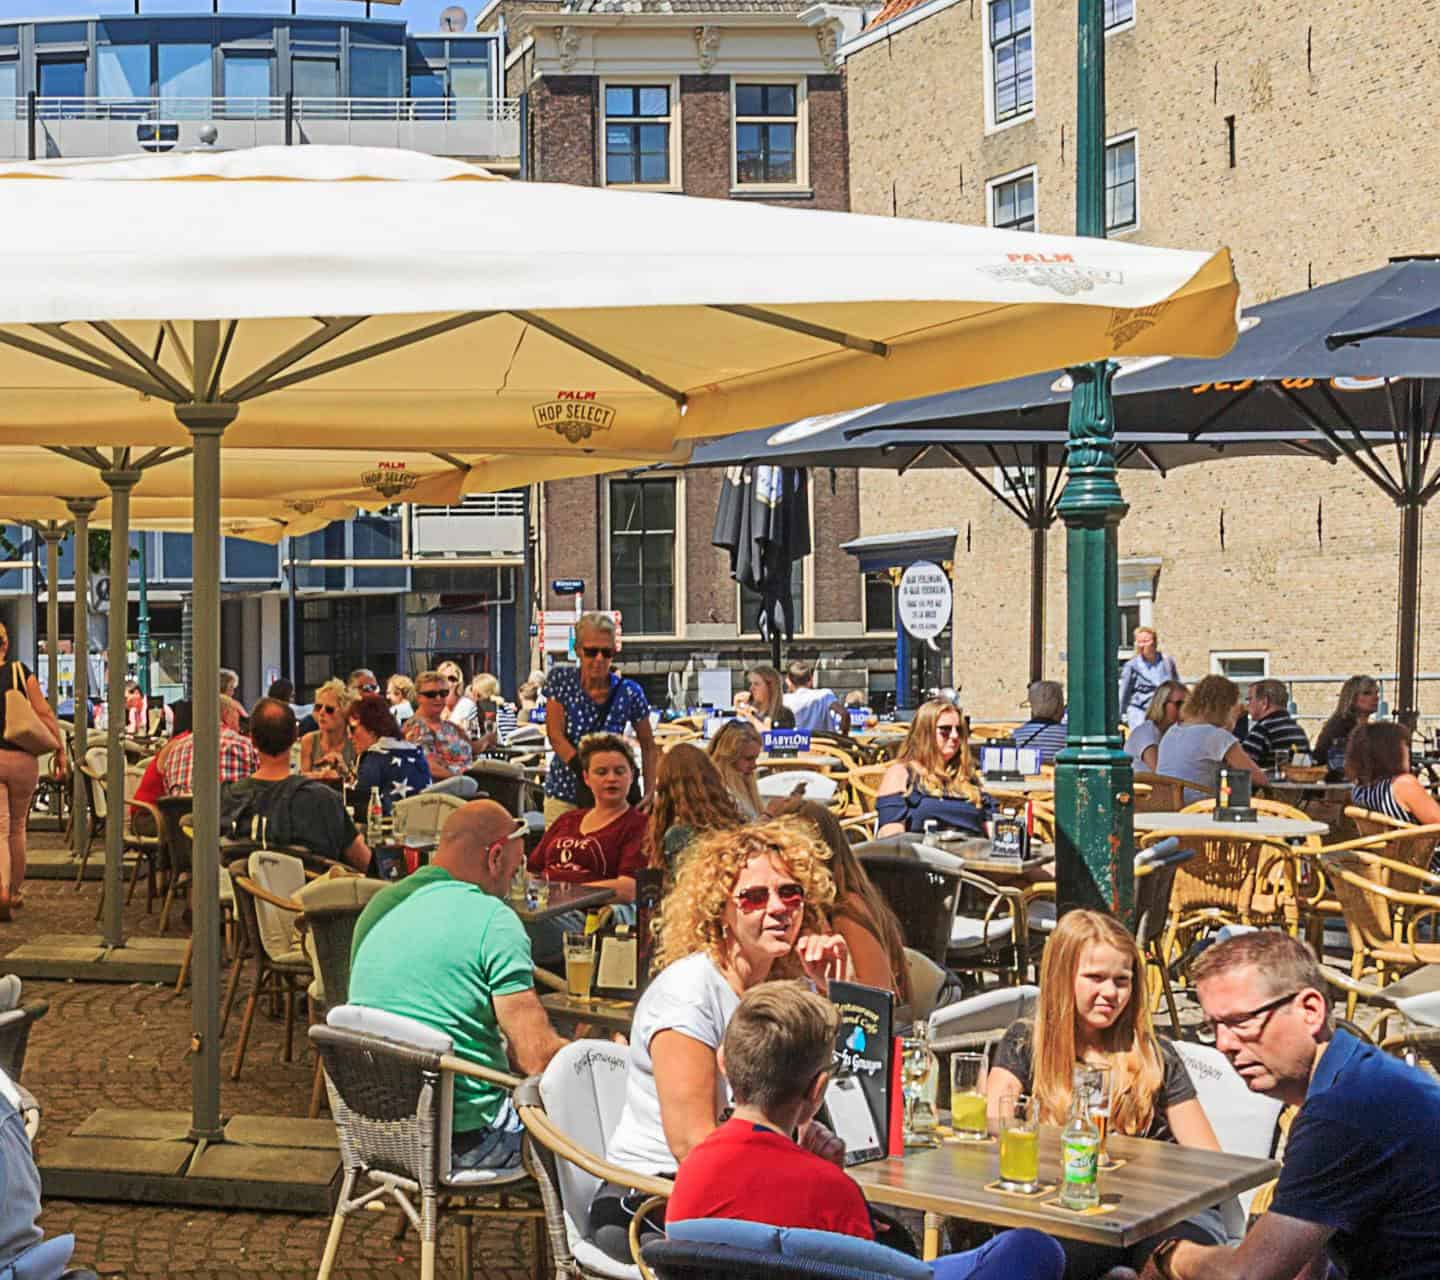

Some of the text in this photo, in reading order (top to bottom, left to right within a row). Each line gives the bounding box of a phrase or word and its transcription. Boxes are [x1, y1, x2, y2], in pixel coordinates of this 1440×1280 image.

[557, 391, 597, 401] PALM
[537, 403, 610, 425] HOP SELECT
[378, 461, 406, 469] PALM
[764, 733, 809, 746] BABYLON
